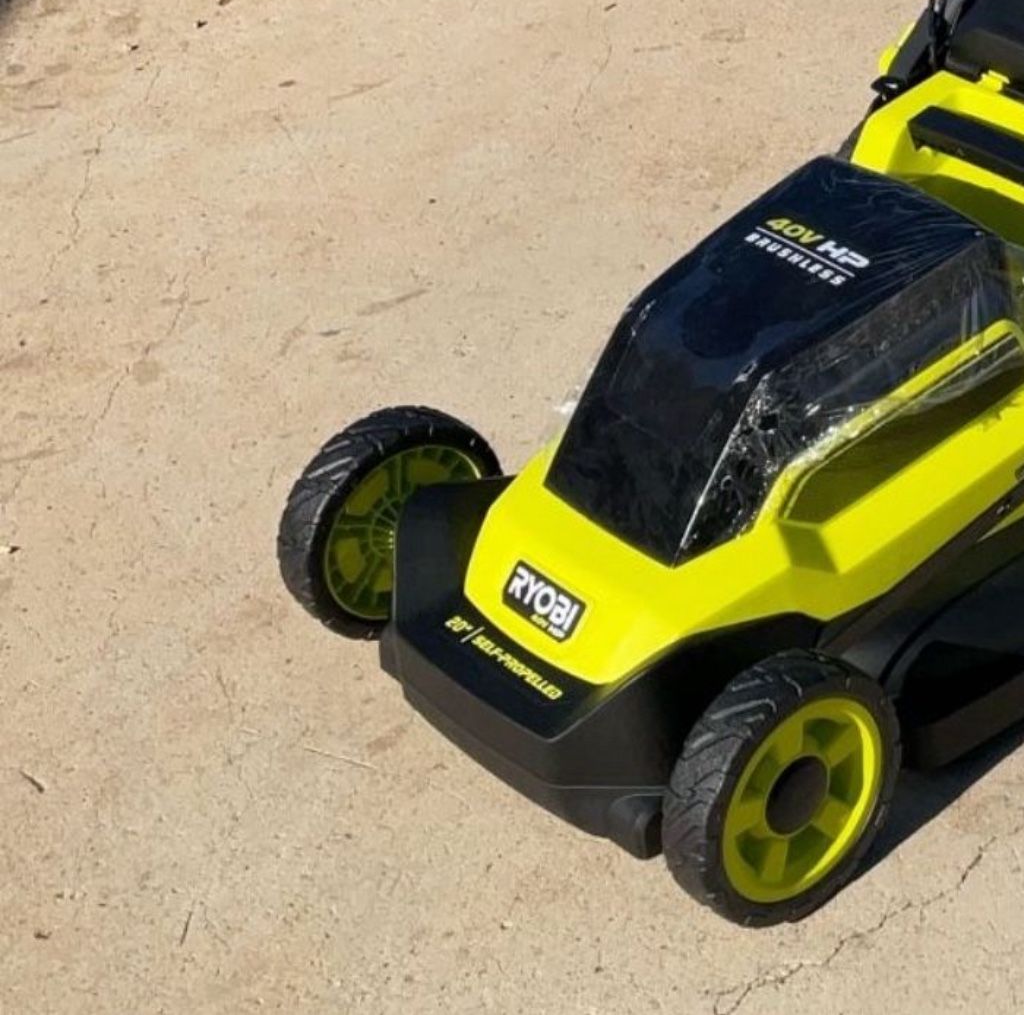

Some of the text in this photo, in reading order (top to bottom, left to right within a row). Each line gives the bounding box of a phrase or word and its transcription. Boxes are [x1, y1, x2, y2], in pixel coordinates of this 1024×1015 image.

[745, 232, 846, 286] BRUSHLESS
[766, 218, 870, 269] 40V HP
[508, 566, 580, 631] RYOBI
[472, 635, 563, 700] SELF-PROPELLED
